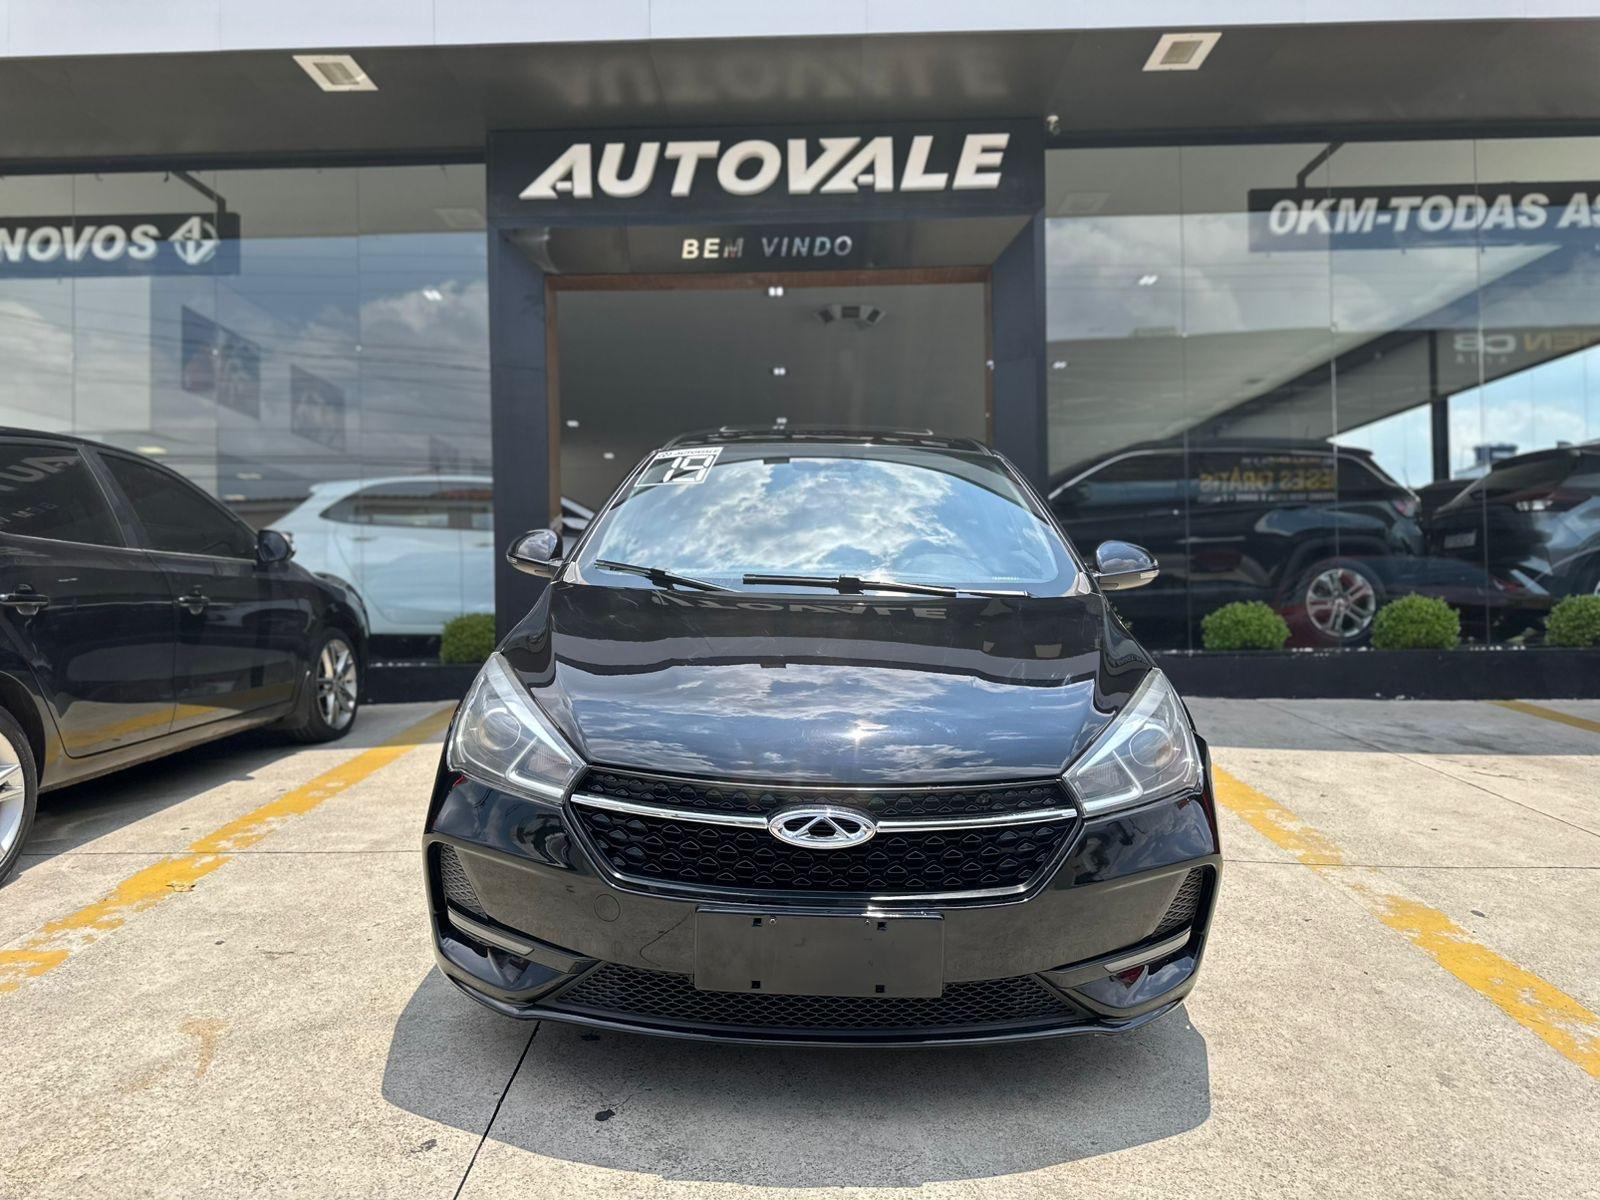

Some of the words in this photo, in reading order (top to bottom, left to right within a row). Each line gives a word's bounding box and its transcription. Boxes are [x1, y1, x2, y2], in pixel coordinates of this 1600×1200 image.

[519, 133, 1010, 199] AUTOVALE
[1556, 192, 1600, 229] A
[0, 224, 162, 263] NOVOS
[681, 237, 744, 259] BEM
[761, 235, 853, 258] VINDO
[663, 455, 714, 483] 19
